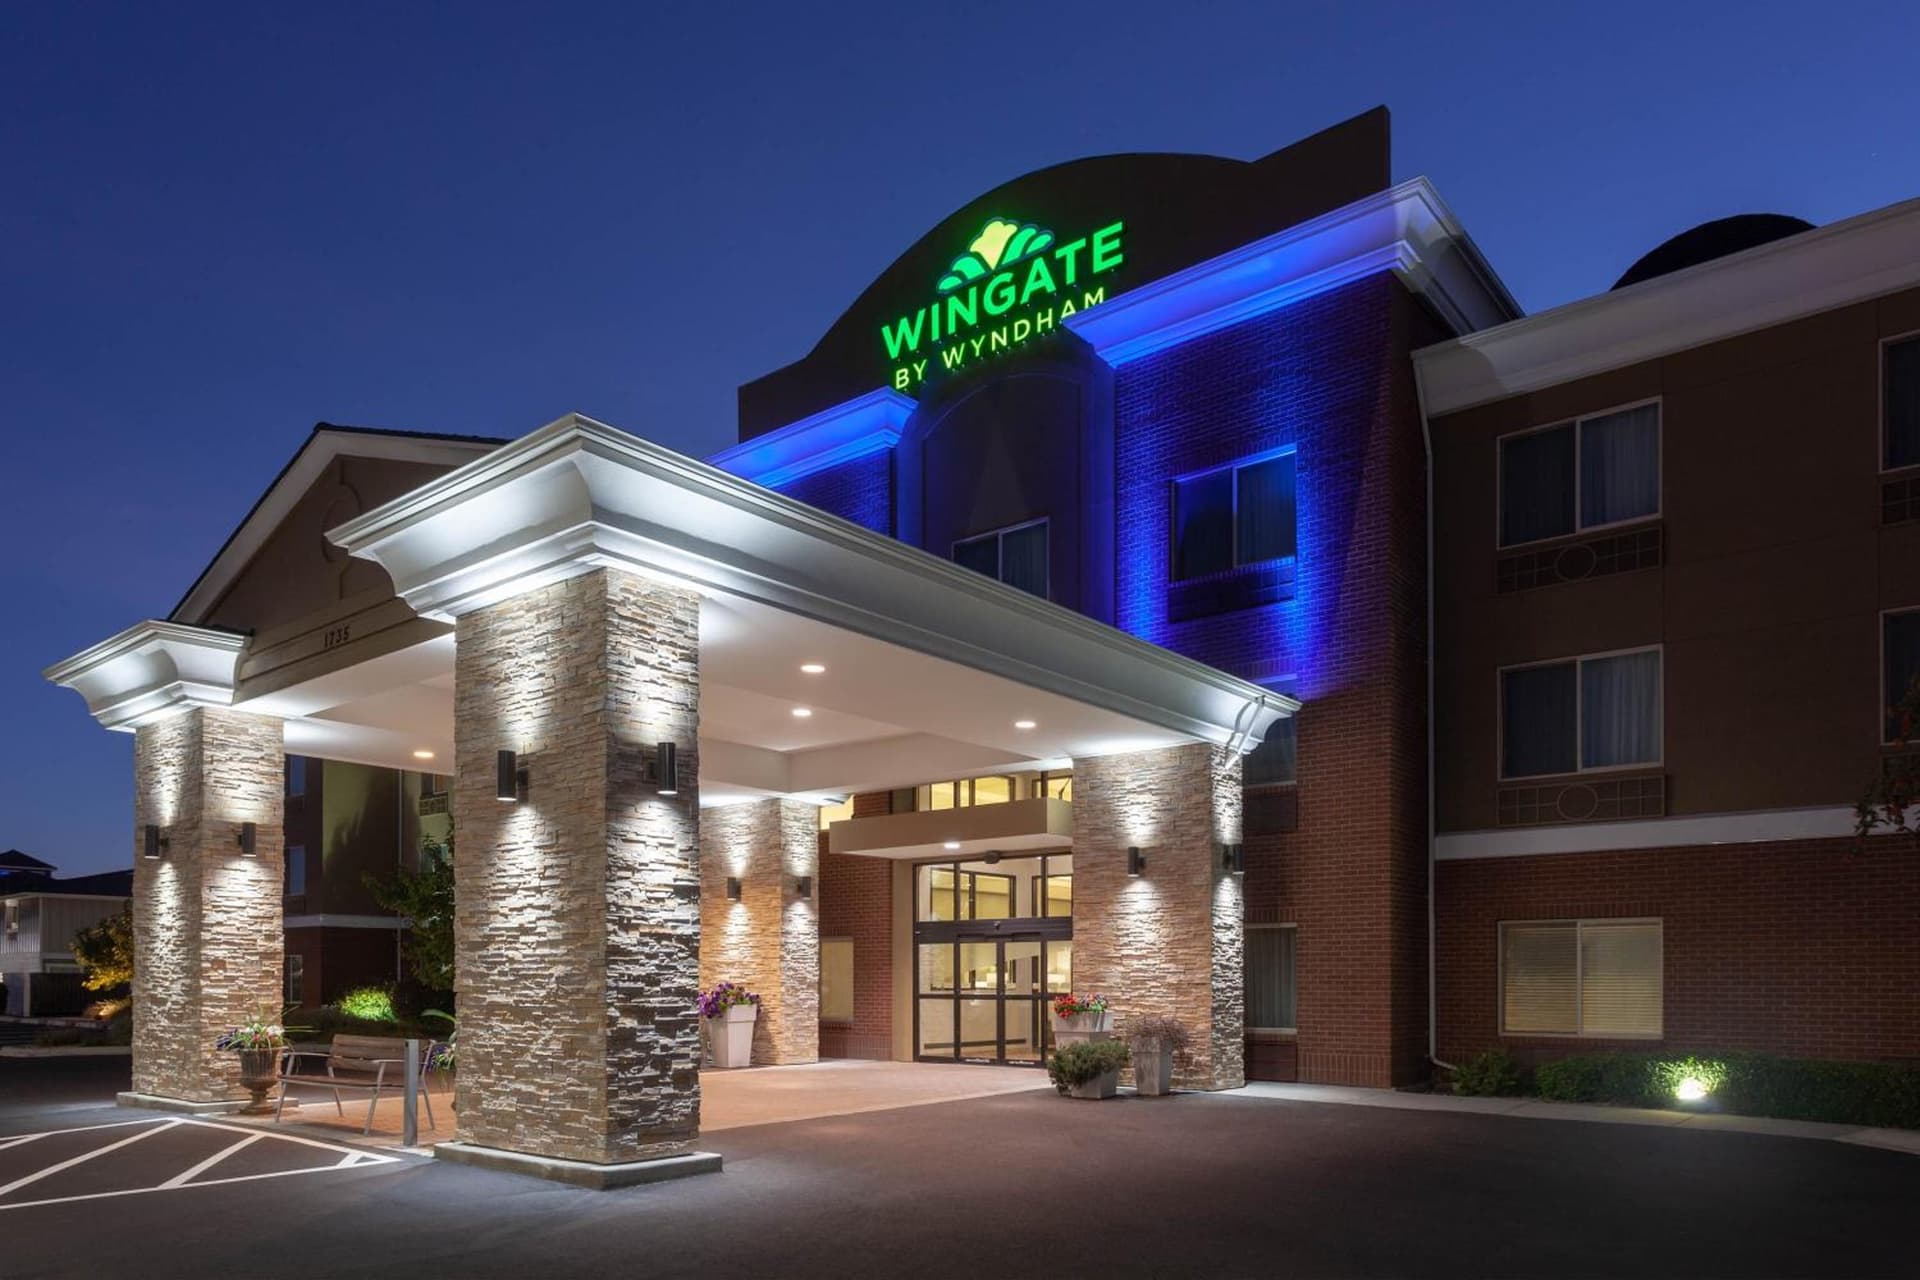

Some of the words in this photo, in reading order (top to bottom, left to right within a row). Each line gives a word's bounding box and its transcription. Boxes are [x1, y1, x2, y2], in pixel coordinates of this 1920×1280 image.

[881, 221, 1123, 360] WINGATE
[895, 359, 928, 389] BY
[942, 286, 1104, 369] WYNDHAM
